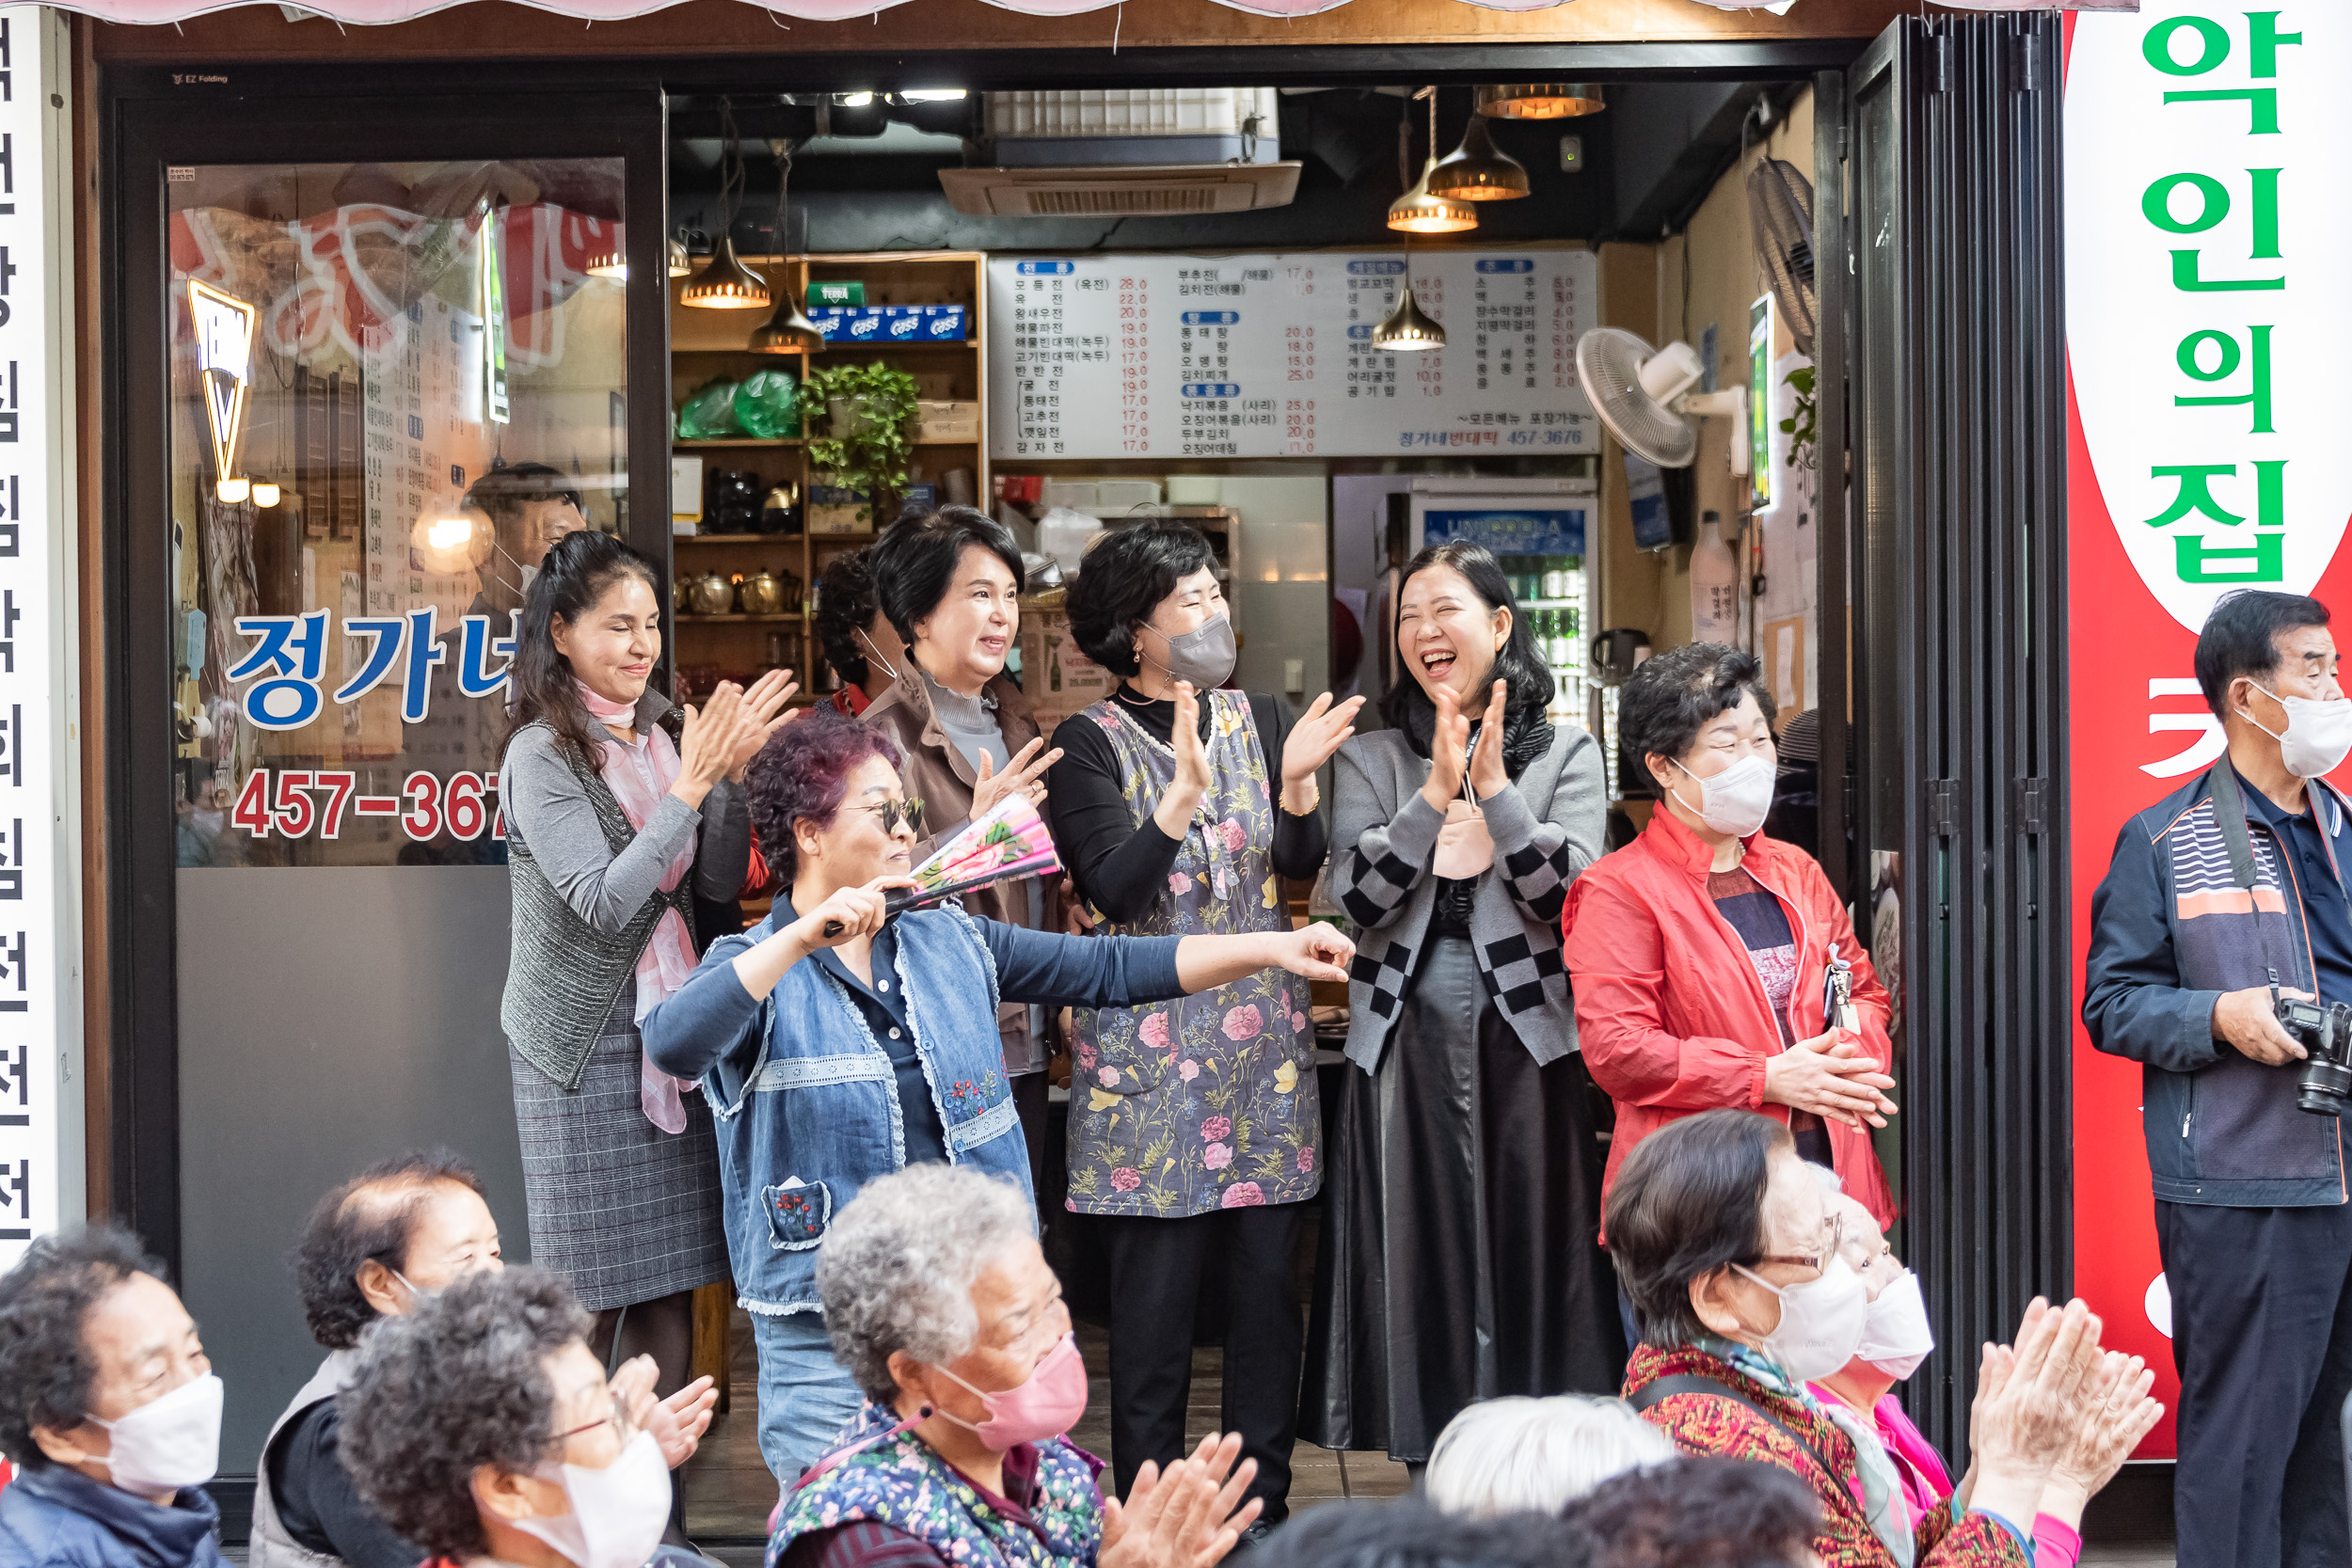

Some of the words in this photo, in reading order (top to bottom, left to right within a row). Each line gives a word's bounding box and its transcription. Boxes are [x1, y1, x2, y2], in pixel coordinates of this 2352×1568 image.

[185, 74, 197, 84] EZ
[199, 74, 229, 84] Folding
[821, 286, 849, 300] TERRA
